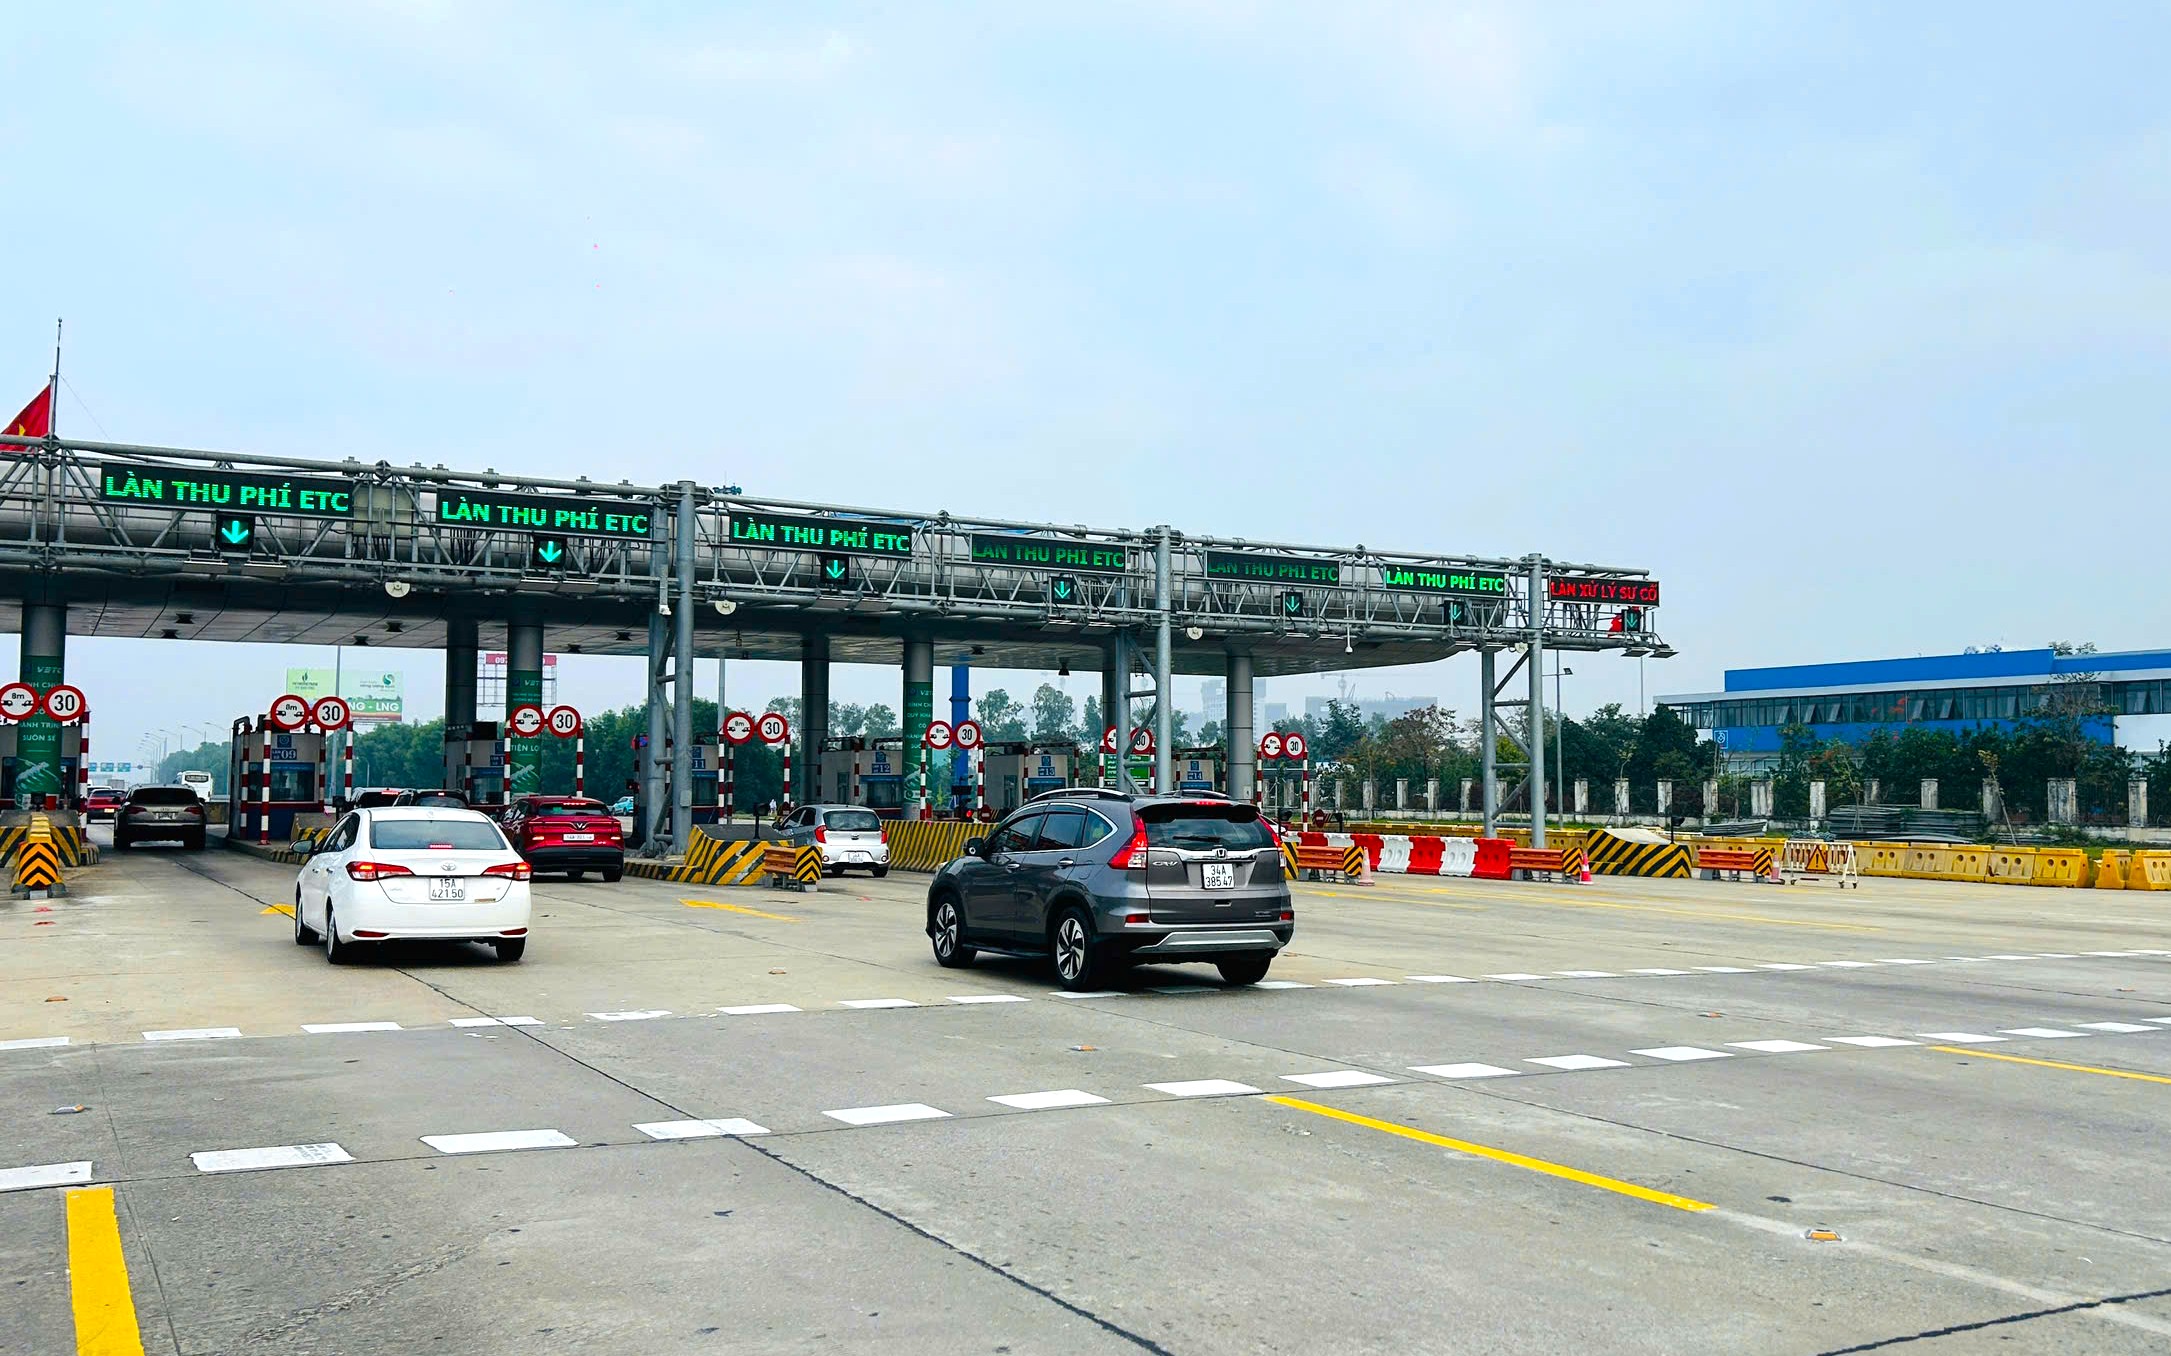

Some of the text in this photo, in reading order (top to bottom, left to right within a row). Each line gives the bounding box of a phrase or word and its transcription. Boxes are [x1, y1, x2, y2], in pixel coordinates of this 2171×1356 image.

[105, 470, 349, 512] LÀN THU PHÍ ETC
[442, 496, 648, 534] LÀN THU PHÍ ETC
[733, 517, 910, 551] LÀN THU PHÍ ETC
[1013, 544, 1050, 562] THU
[1093, 551, 1124, 568] ETC
[1243, 562, 1274, 577] THU
[1311, 566, 1338, 582] ETC
[1386, 566, 1504, 592] LÀN THU PHÍ ETC
[1550, 579, 1577, 597] LÀN
[1601, 581, 1617, 598] LÝ
[54, 695, 75, 711] 30
[376, 702, 399, 711] LNG
[321, 705, 341, 721] 30
[556, 714, 573, 729] 30
[764, 721, 780, 735] 30
[961, 729, 973, 741] 30
[1290, 740, 1299, 752] 30
[281, 750, 296, 759] 09
[694, 760, 705, 768] 11
[880, 764, 890, 773] 12
[1045, 767, 1055, 776] 13
[1211, 865, 1226, 876] 34A
[440, 878, 456, 888] 15A
[1205, 876, 1233, 887] 385.47
